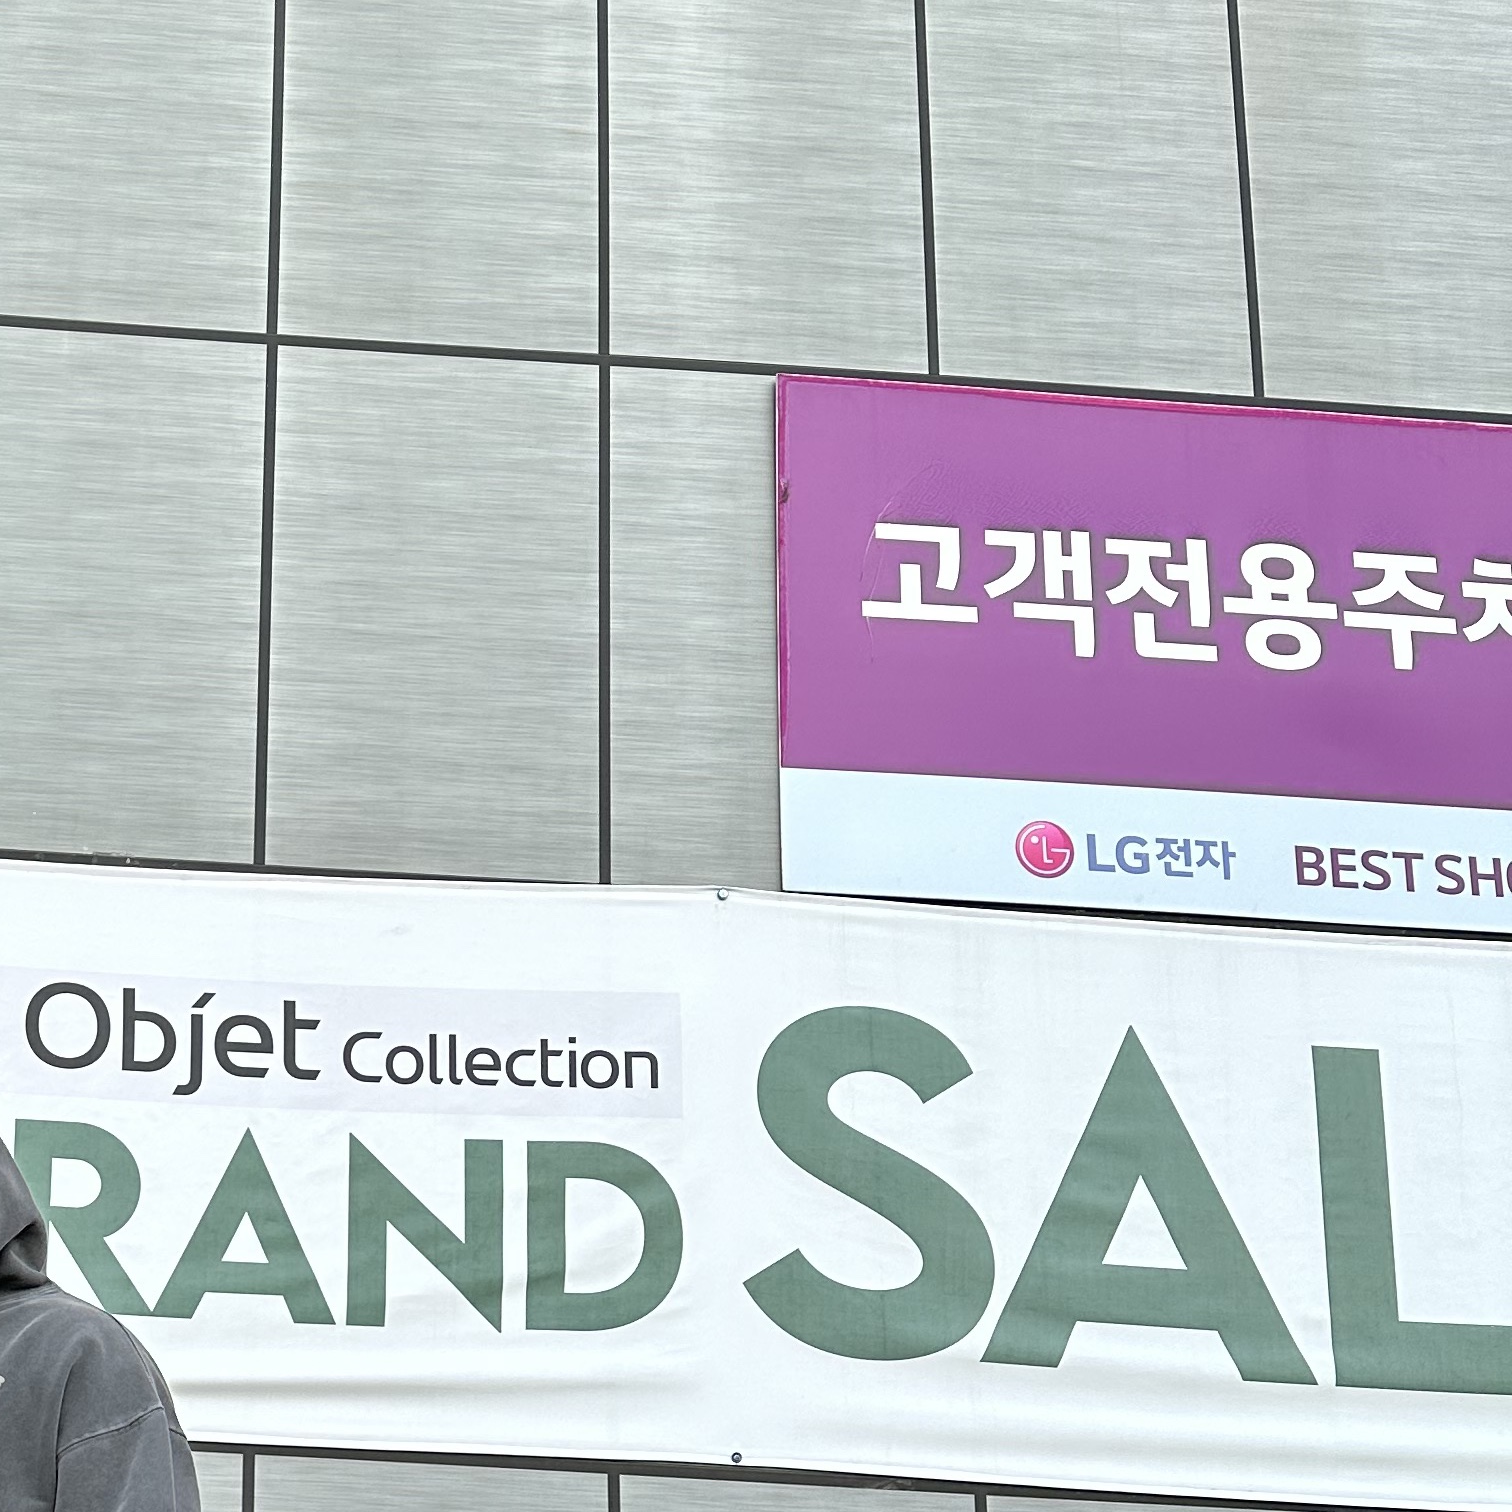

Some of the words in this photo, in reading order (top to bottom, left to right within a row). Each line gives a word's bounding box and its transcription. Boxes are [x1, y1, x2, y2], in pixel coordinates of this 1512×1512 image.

[1086, 833, 1237, 881] LG전자
[1294, 843, 1424, 893] BEST
[1434, 854, 1512, 899] SH
[342, 1030, 659, 1090] Collection
[12, 1117, 685, 1335] RAND
